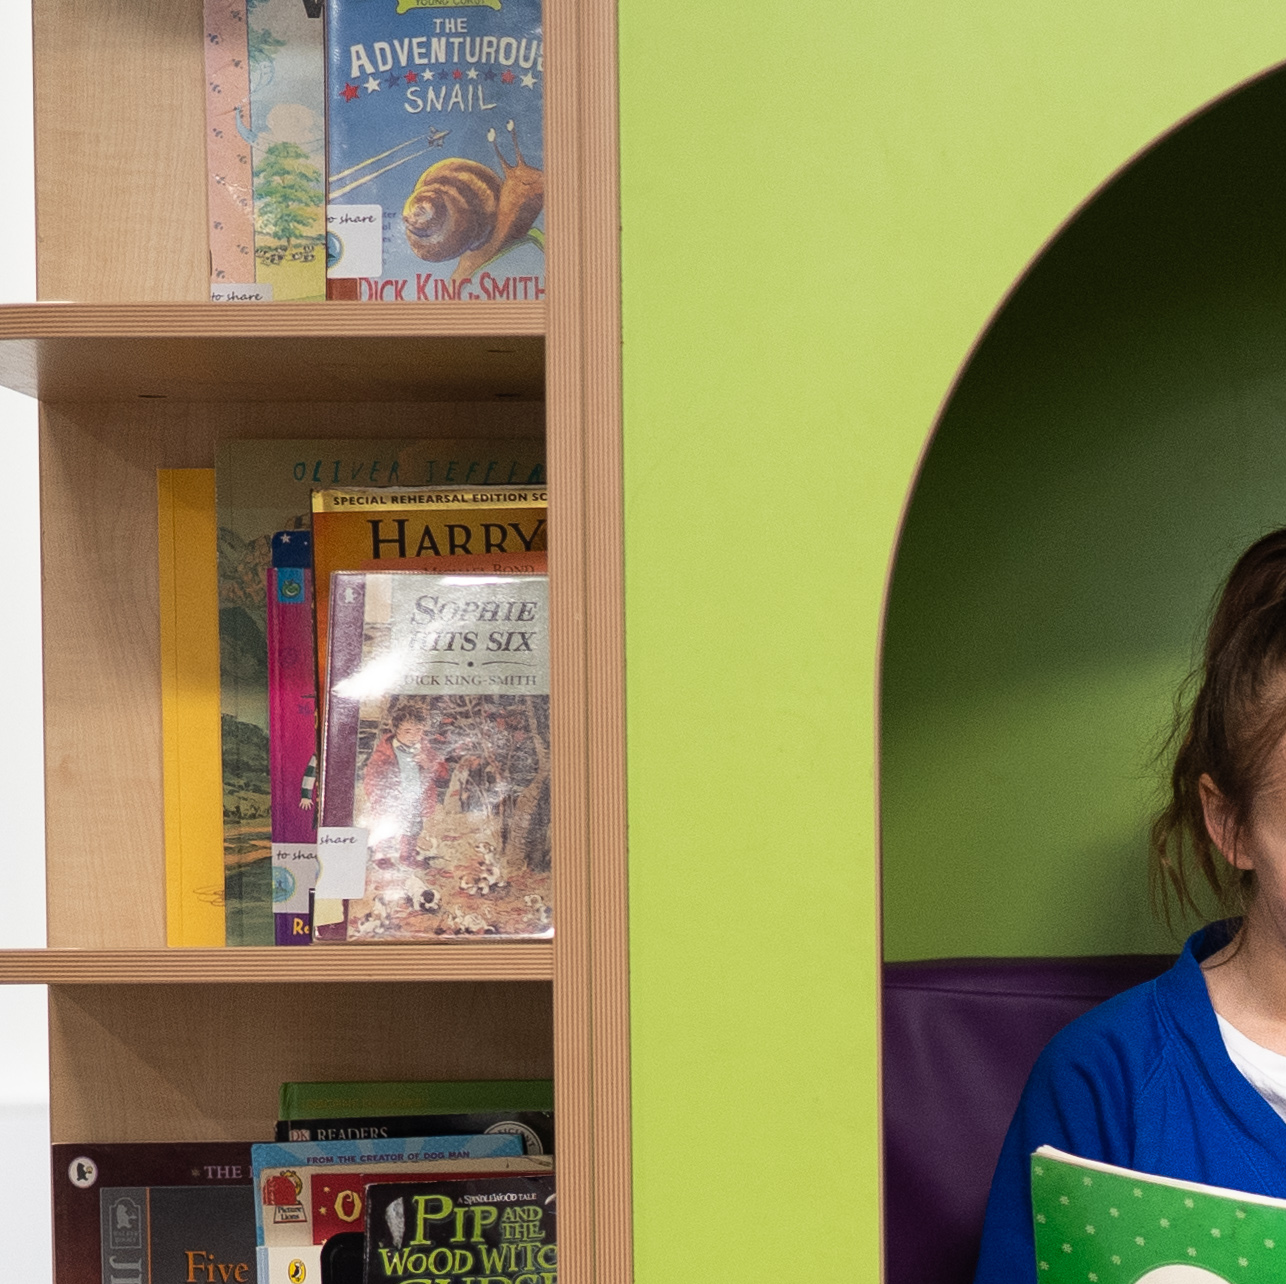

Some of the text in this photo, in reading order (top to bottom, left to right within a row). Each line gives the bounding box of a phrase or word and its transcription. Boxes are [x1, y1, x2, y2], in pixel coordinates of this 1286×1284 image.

[433, 18, 467, 34] THE
[350, 35, 544, 78] ADVENTUROU
[404, 84, 497, 114] SNAIL
[339, 212, 376, 224] share
[333, 493, 527, 506] SPECIAL REHEARSAL EDITION
[366, 518, 548, 560] HARRY
[410, 595, 538, 626] SOPHIE
[485, 631, 537, 652] SIX
[445, 674, 537, 686] KING-SMITH
[317, 1126, 389, 1141] READERS
[306, 1151, 470, 1165] FROM THE CREATOR OF DOG MAN
[204, 1165, 243, 1180] THE
[518, 1192, 538, 1202] TALE
[502, 1205, 543, 1221] AND
[501, 1222, 546, 1241] THE
[184, 1251, 250, 1284] Five
[379, 1247, 475, 1276] WOOD
